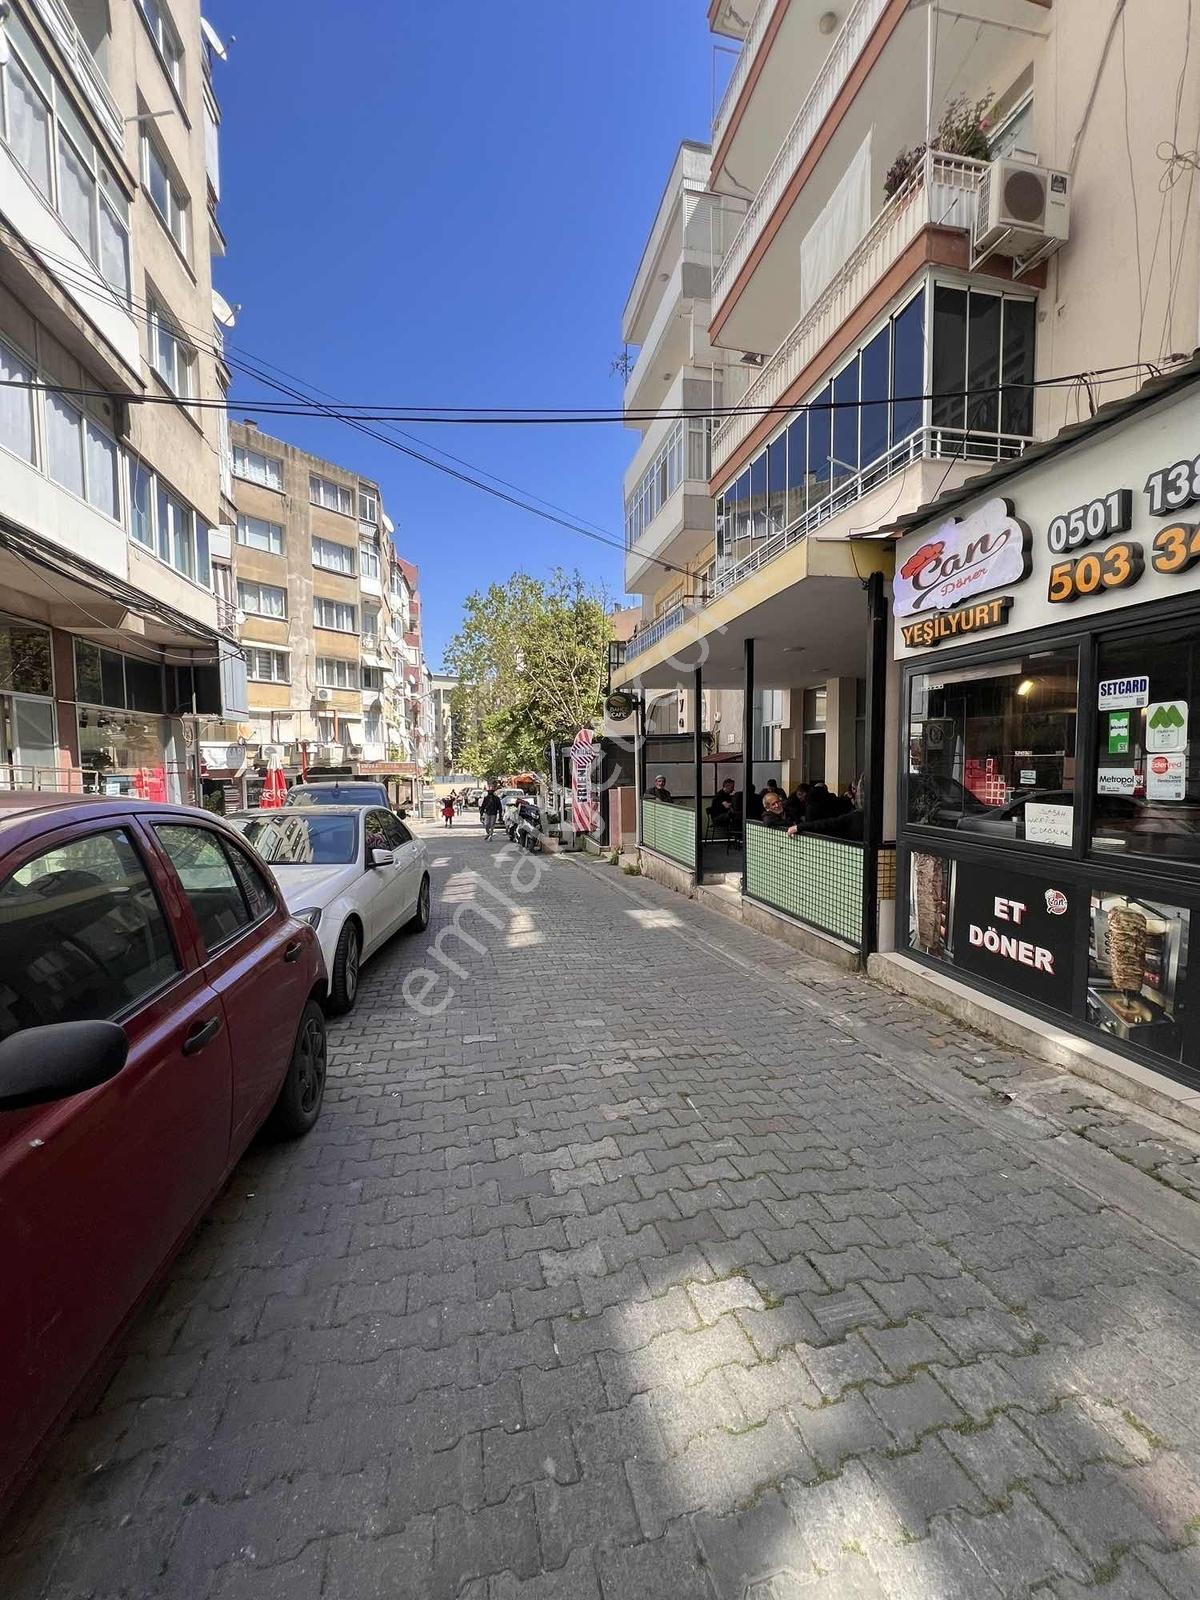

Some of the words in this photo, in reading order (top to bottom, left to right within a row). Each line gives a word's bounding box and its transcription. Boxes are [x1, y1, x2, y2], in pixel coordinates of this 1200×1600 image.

[1050, 493, 1120, 551] 0501
[940, 567, 988, 597] Döner
[1050, 545, 1131, 601] 503
[903, 599, 1003, 646] YEŞİLYURT
[1100, 679, 1147, 697] SETCARD
[1100, 775, 1135, 785] Metropol
[994, 896, 1026, 925] ET
[969, 924, 1056, 976] DÖNER
